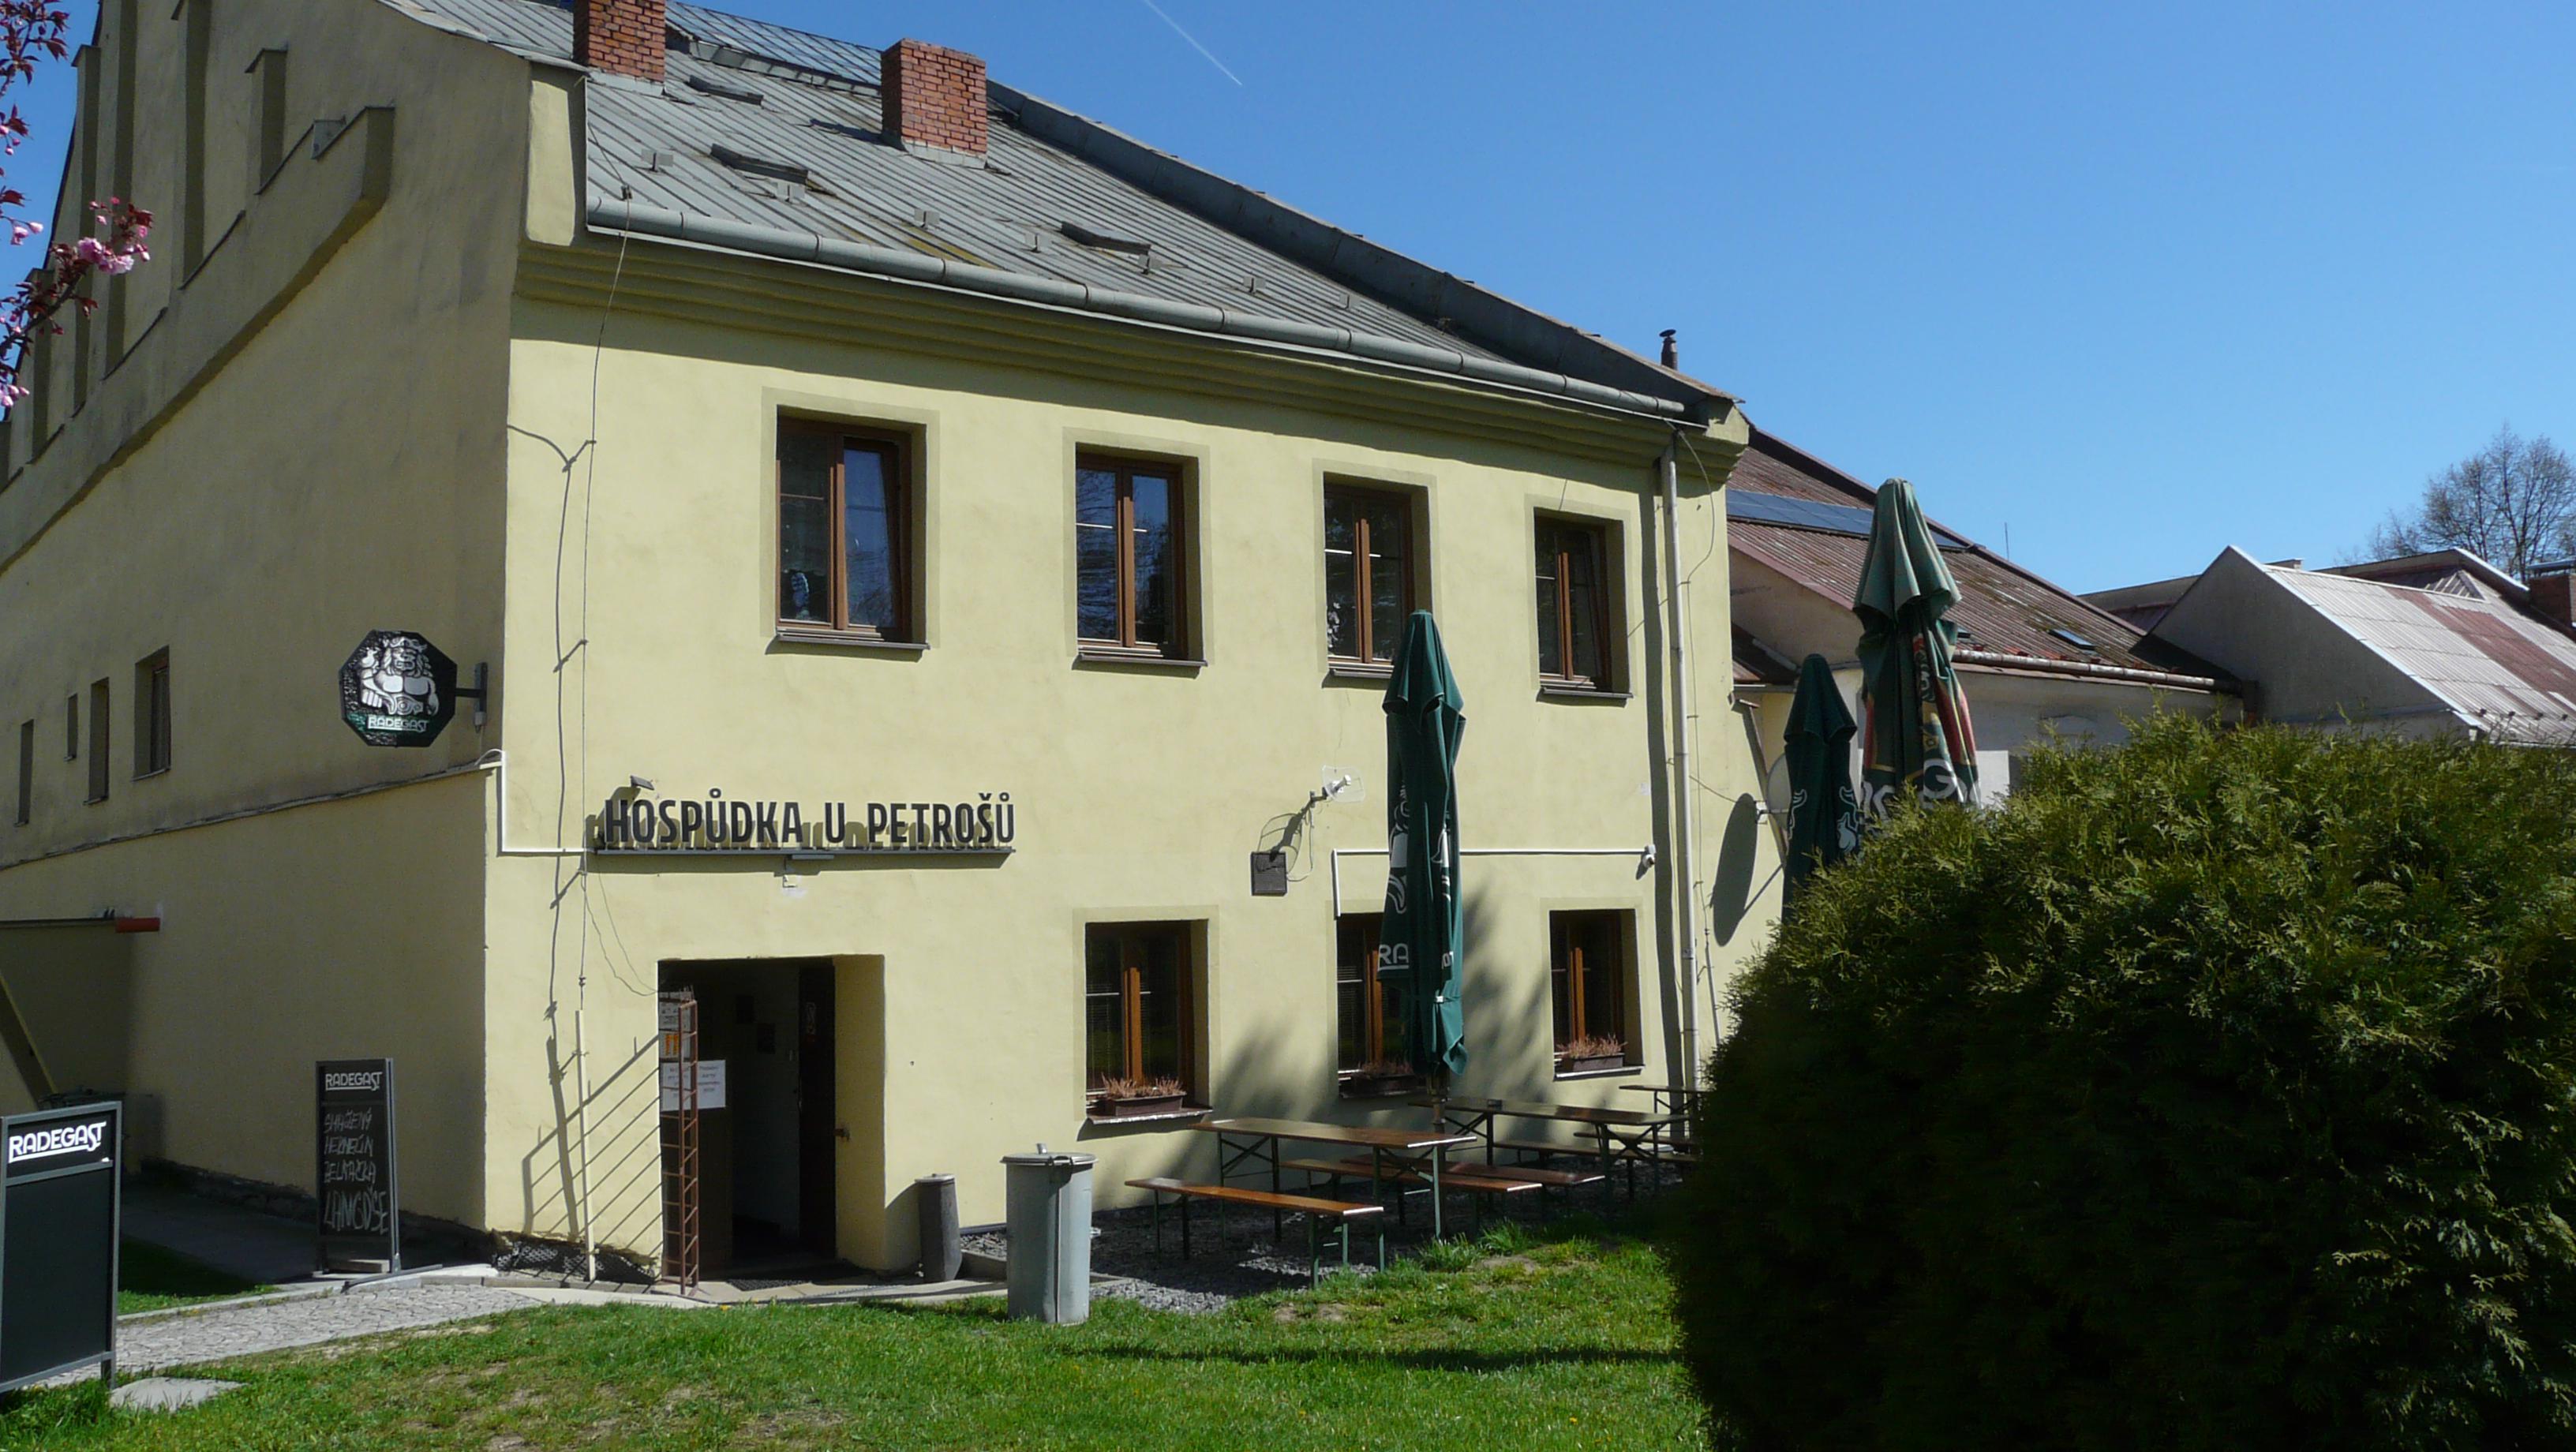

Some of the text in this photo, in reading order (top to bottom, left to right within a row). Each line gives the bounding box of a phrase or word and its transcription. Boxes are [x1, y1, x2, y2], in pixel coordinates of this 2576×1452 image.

[367, 715, 429, 732] RADEGAST
[605, 788, 1015, 844] HOSPŮDKA U PETROŠŮ
[325, 1071, 383, 1091] RADEGAST
[8, 1121, 107, 1163] RADEGAST
